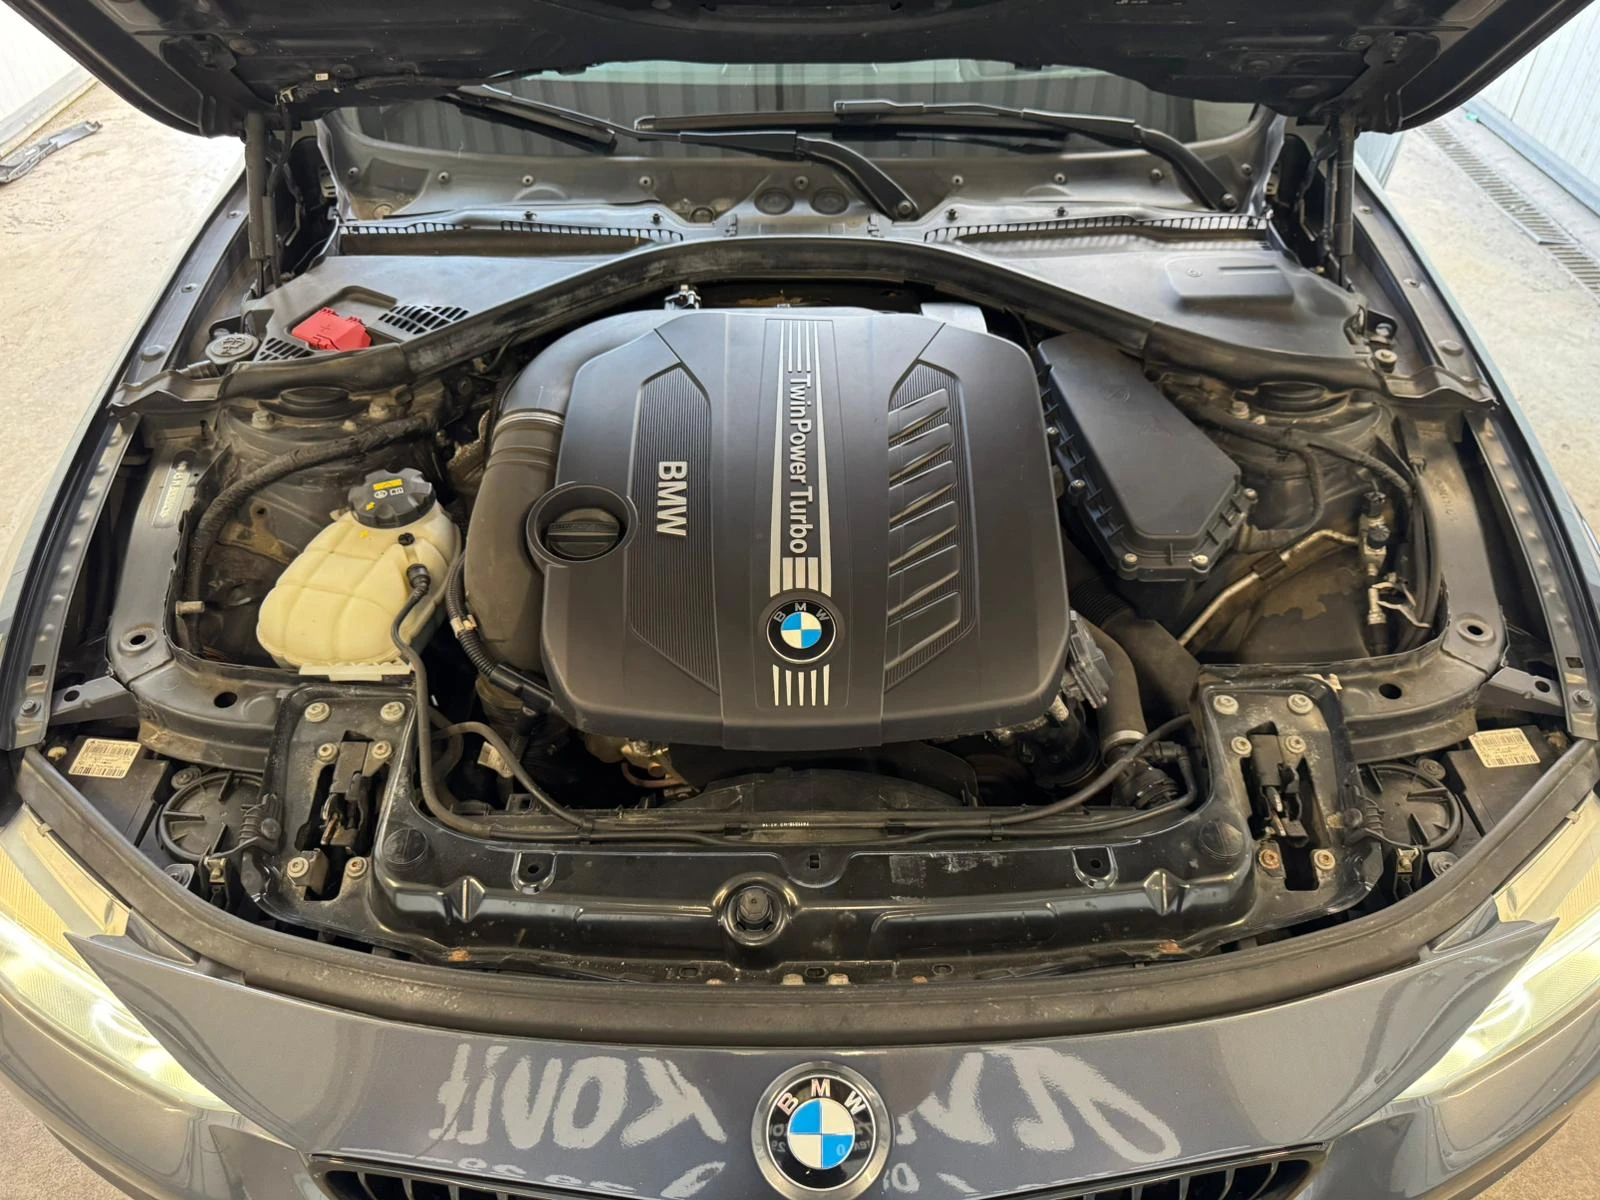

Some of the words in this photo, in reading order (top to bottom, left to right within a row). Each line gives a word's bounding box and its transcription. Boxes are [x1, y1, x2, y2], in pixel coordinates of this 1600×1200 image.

[790, 372, 812, 485] TwinPower
[656, 461, 688, 537] BMW
[789, 485, 814, 554] Turbo
[773, 602, 830, 623] BMW
[777, 1078, 867, 1117] BMW
